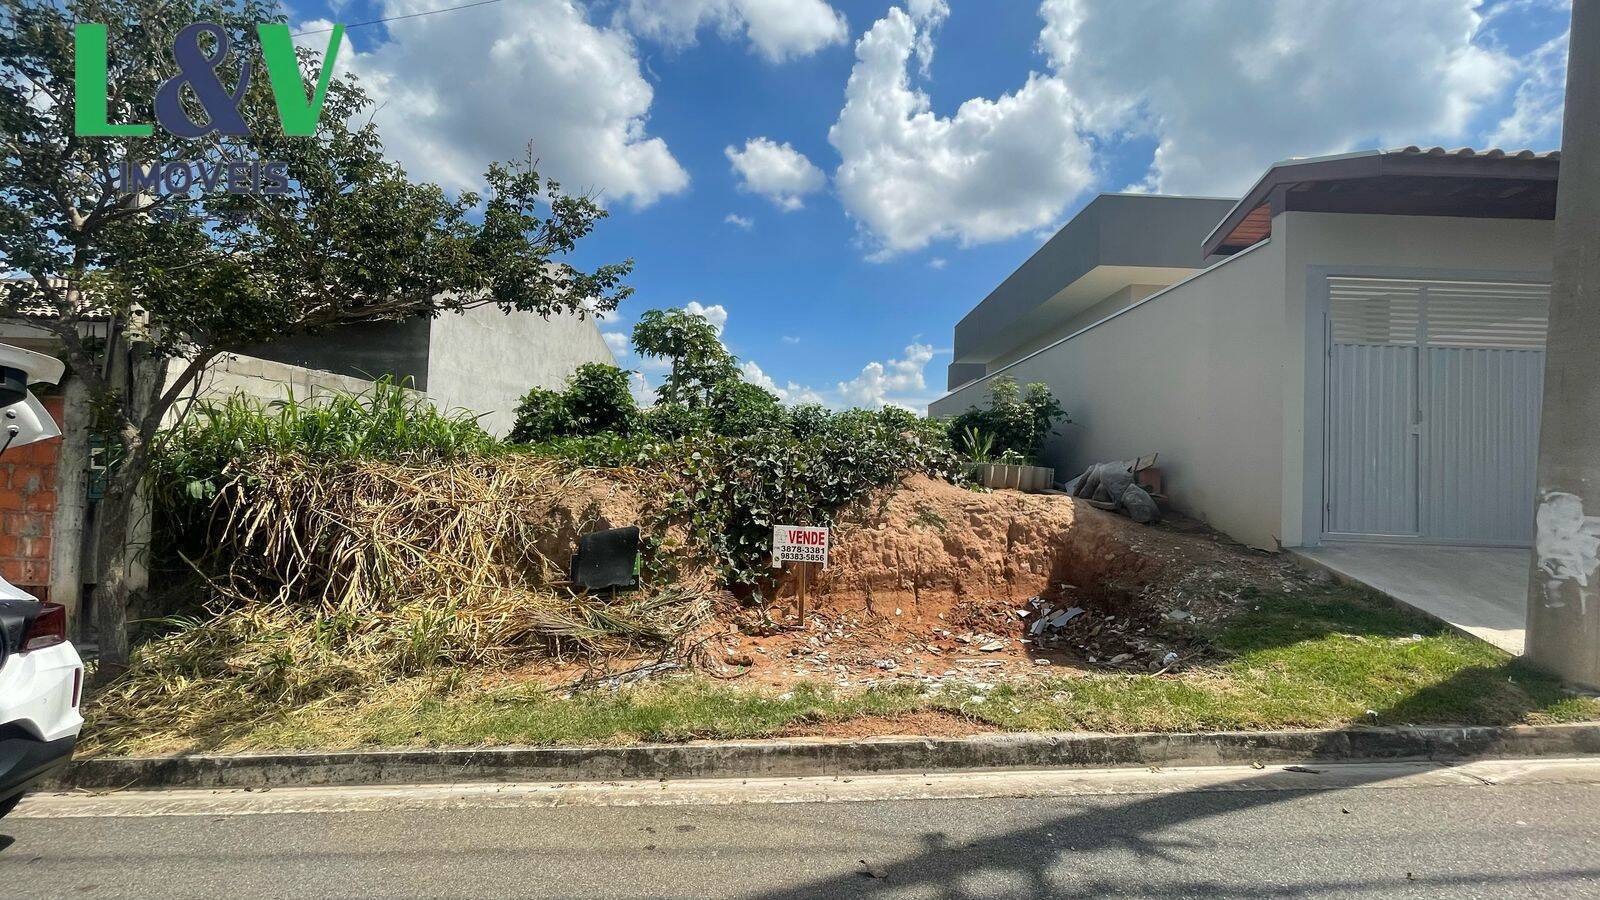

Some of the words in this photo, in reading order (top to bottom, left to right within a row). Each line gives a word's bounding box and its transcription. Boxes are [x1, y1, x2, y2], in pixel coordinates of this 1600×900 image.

[788, 530, 825, 545] VENDE
[781, 545, 825, 554] 3878-3381
[781, 552, 825, 561] 98383-5856
